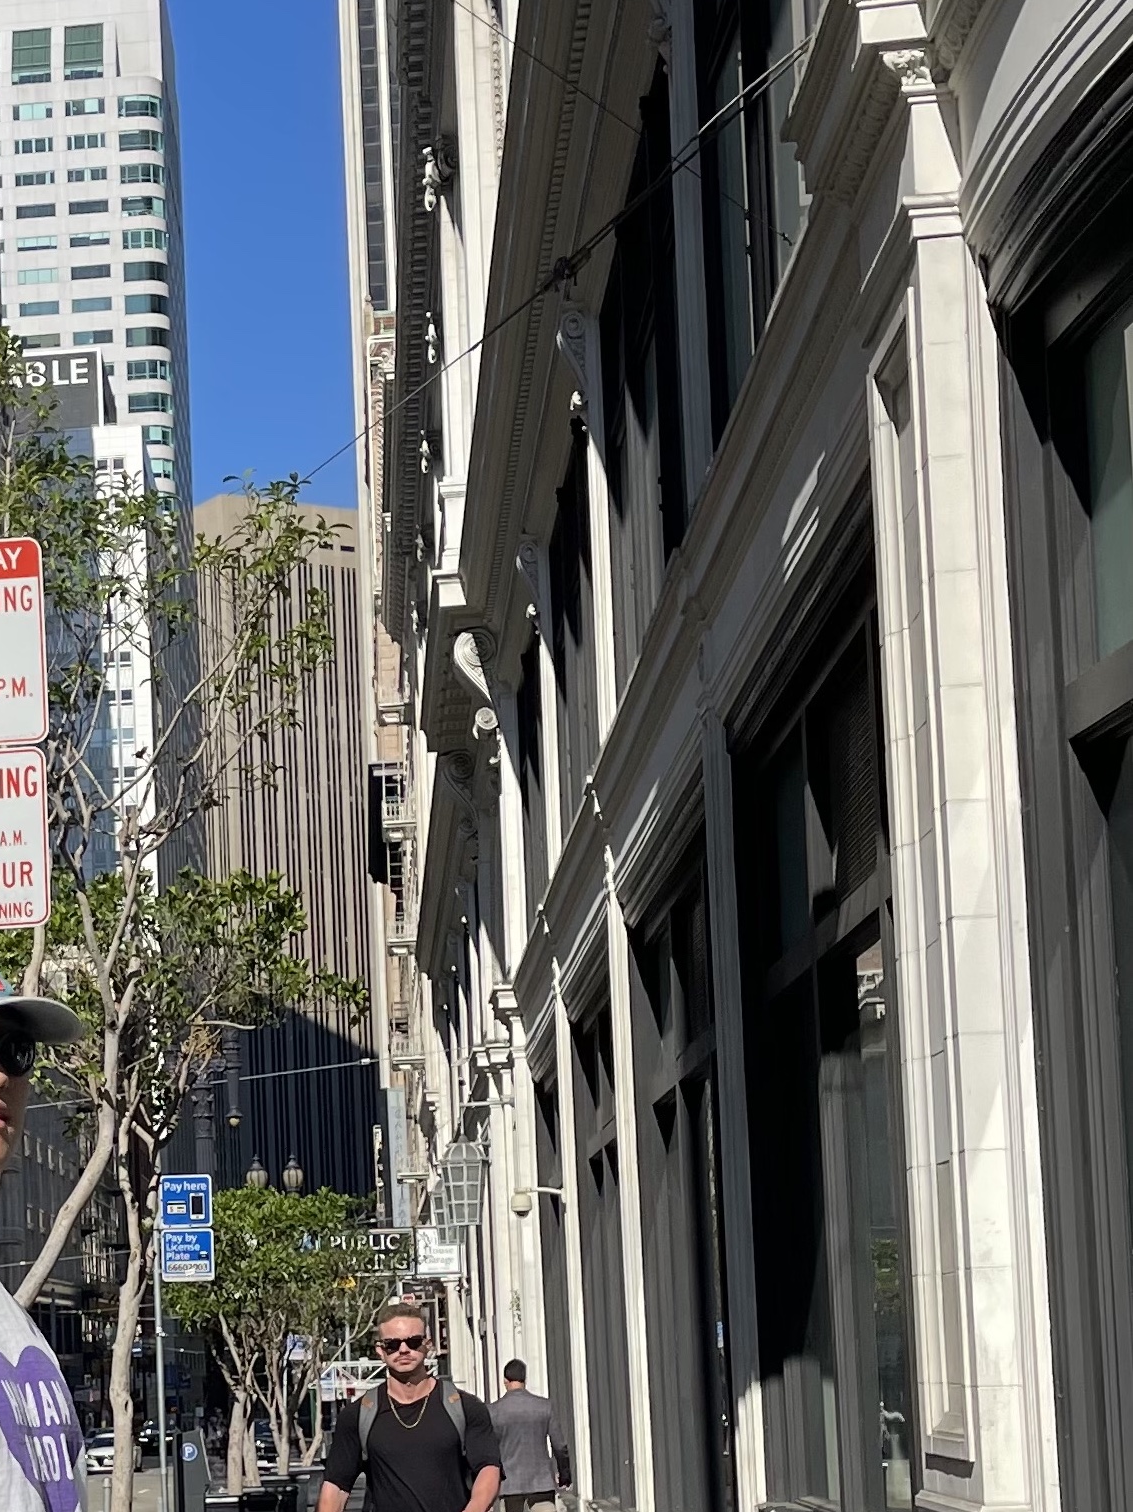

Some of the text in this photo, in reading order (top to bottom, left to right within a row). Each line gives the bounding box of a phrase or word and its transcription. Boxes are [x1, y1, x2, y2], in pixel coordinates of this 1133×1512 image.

[163, 1181, 207, 1194] Pay here
[165, 1232, 198, 1244] Pay by
[166, 1242, 201, 1251] License
[166, 1251, 191, 1260] Plate
